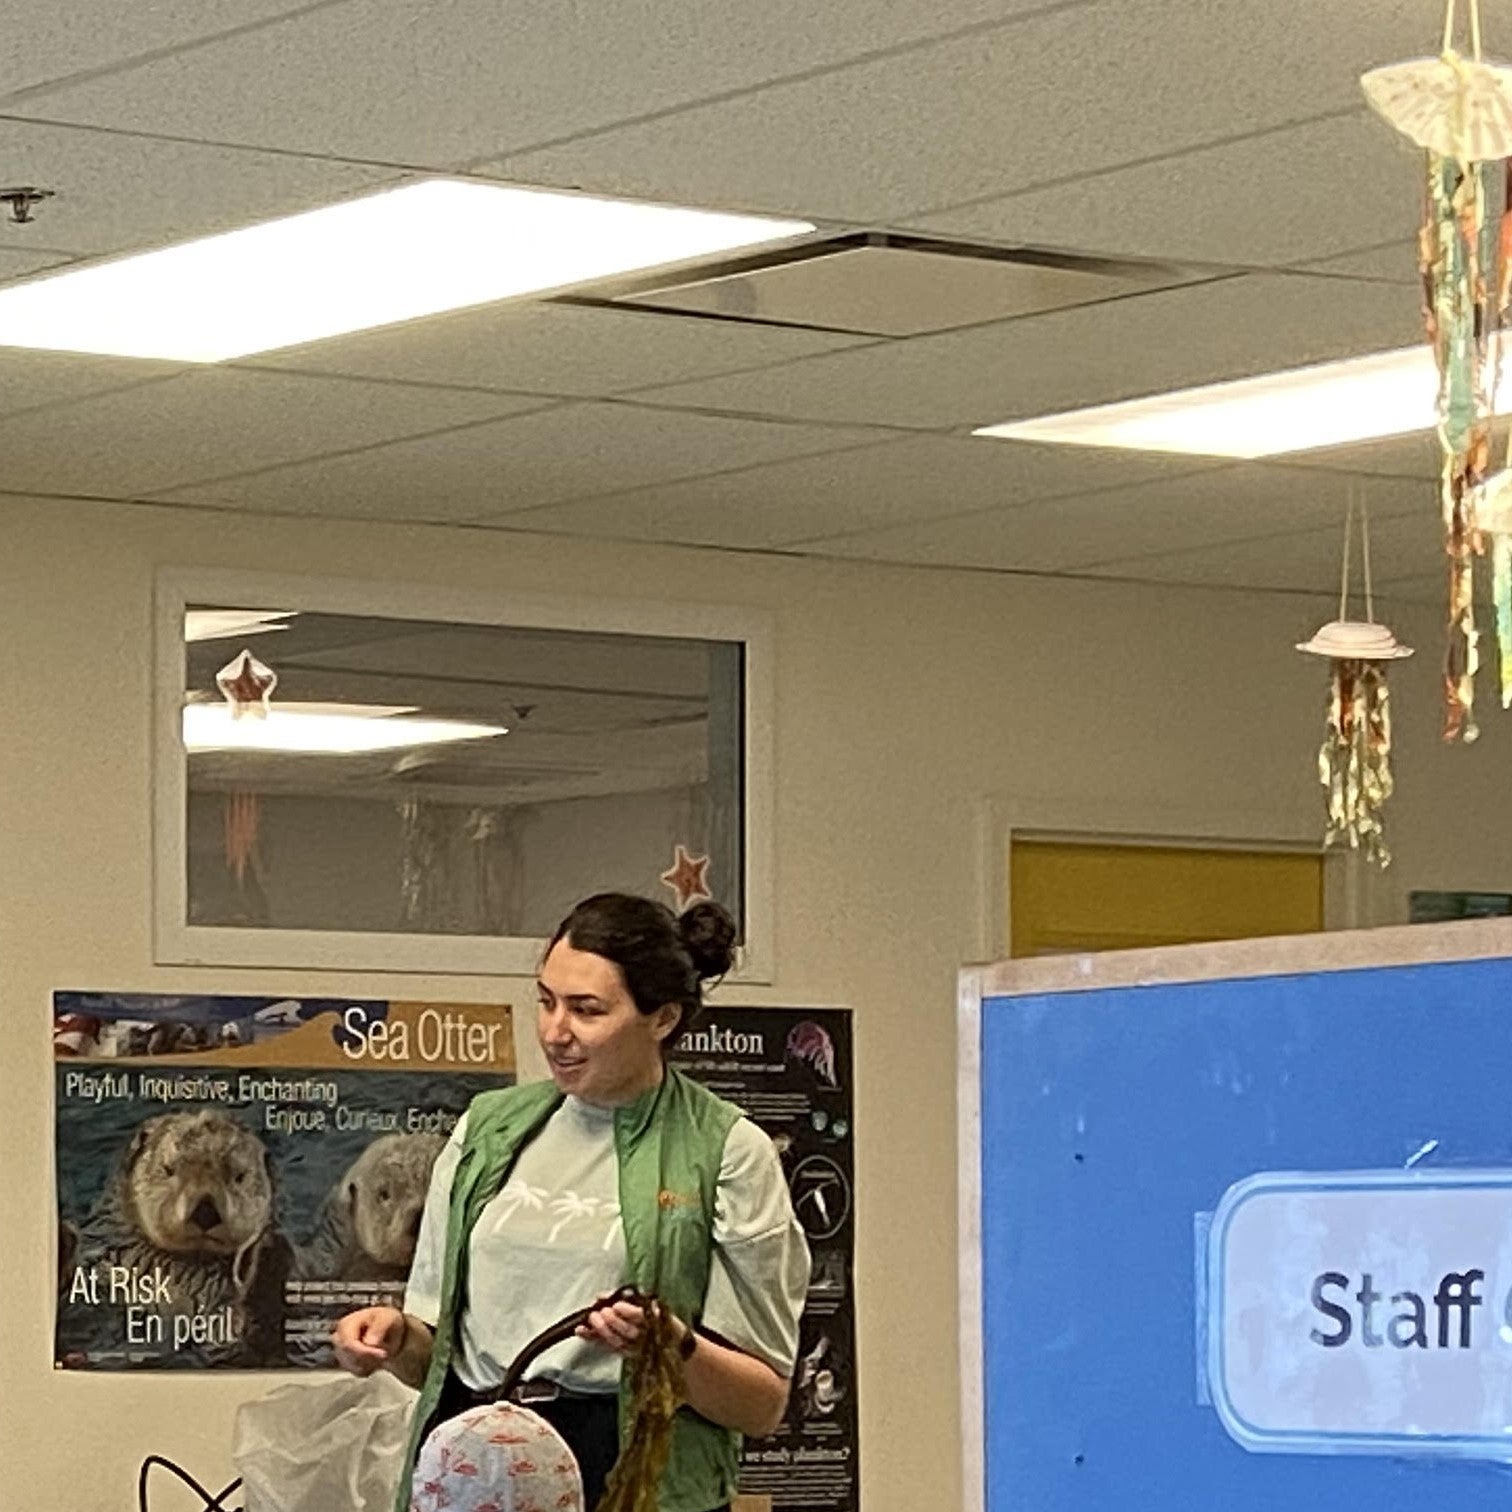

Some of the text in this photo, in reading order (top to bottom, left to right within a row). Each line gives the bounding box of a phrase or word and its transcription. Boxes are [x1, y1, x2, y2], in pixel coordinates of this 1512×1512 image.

[343, 1007, 502, 1062] Sea Otter
[674, 1024, 764, 1055] ankton
[66, 1072, 134, 1104] Playful,
[239, 1075, 337, 1108] Enchanting
[69, 1266, 172, 1305] At Risk
[128, 1304, 239, 1351] En péril
[1309, 1268, 1485, 1349] Staff
